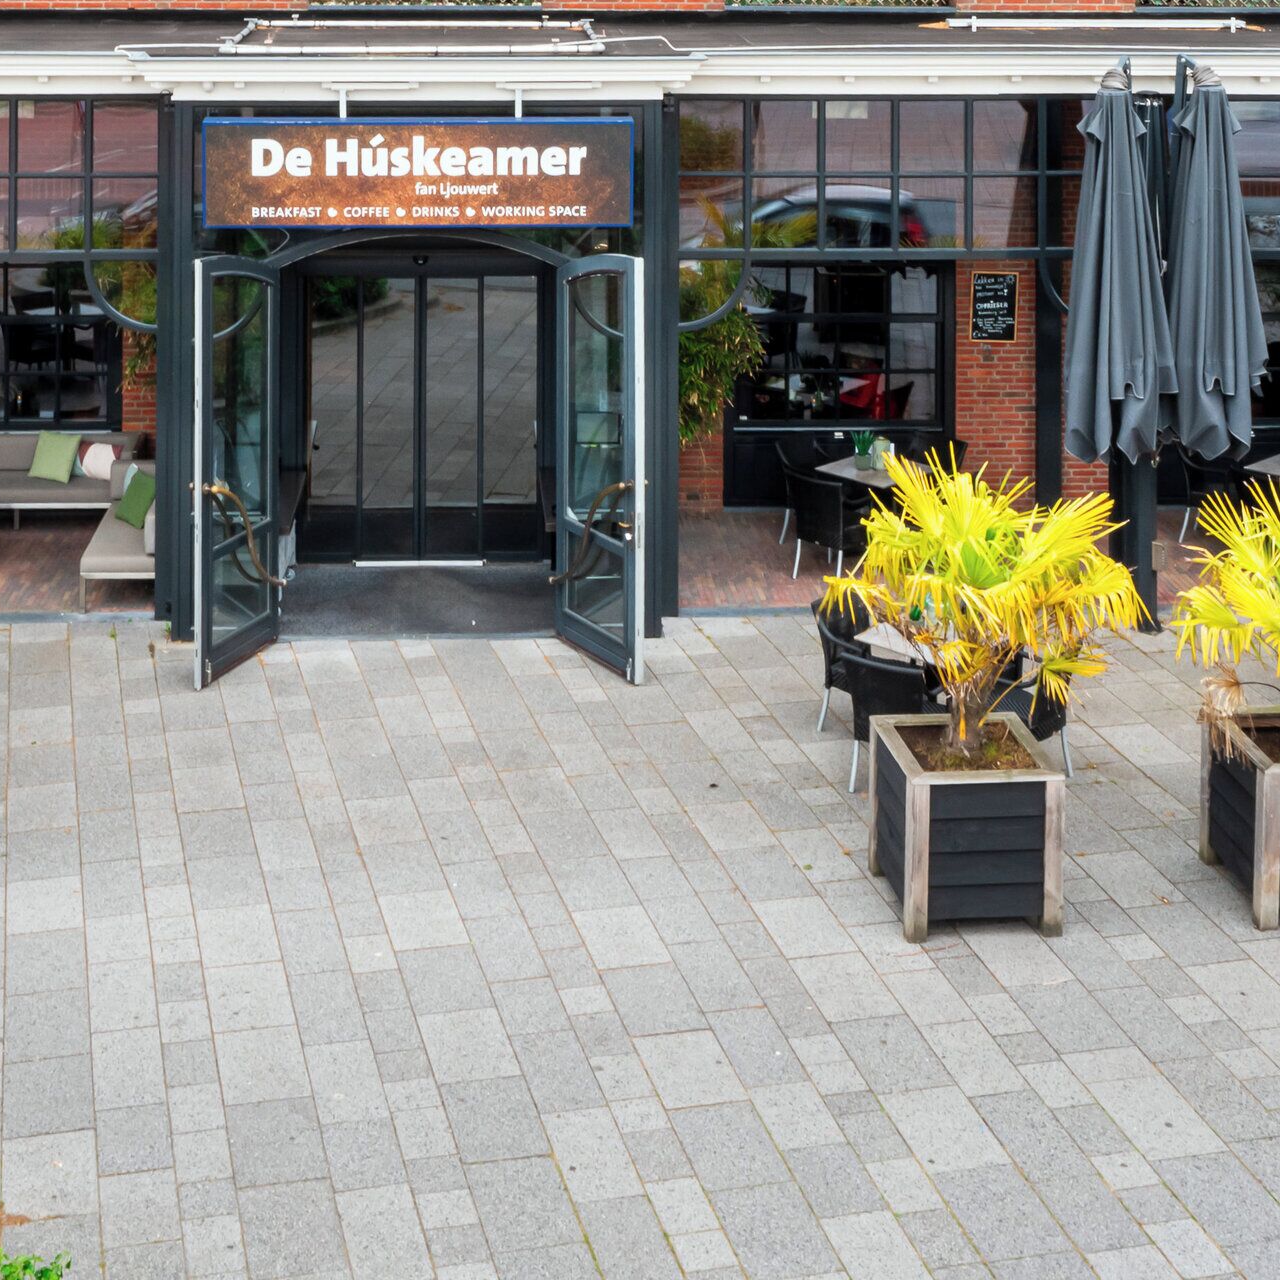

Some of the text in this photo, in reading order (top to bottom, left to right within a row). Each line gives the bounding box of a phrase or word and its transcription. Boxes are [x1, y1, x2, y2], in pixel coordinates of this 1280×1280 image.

[251, 133, 588, 177] De Húskeamer
[414, 182, 499, 199] fan Ljouwert
[251, 205, 587, 218] BREAKFAST COFFEE DRINKS WORKING SPACE
